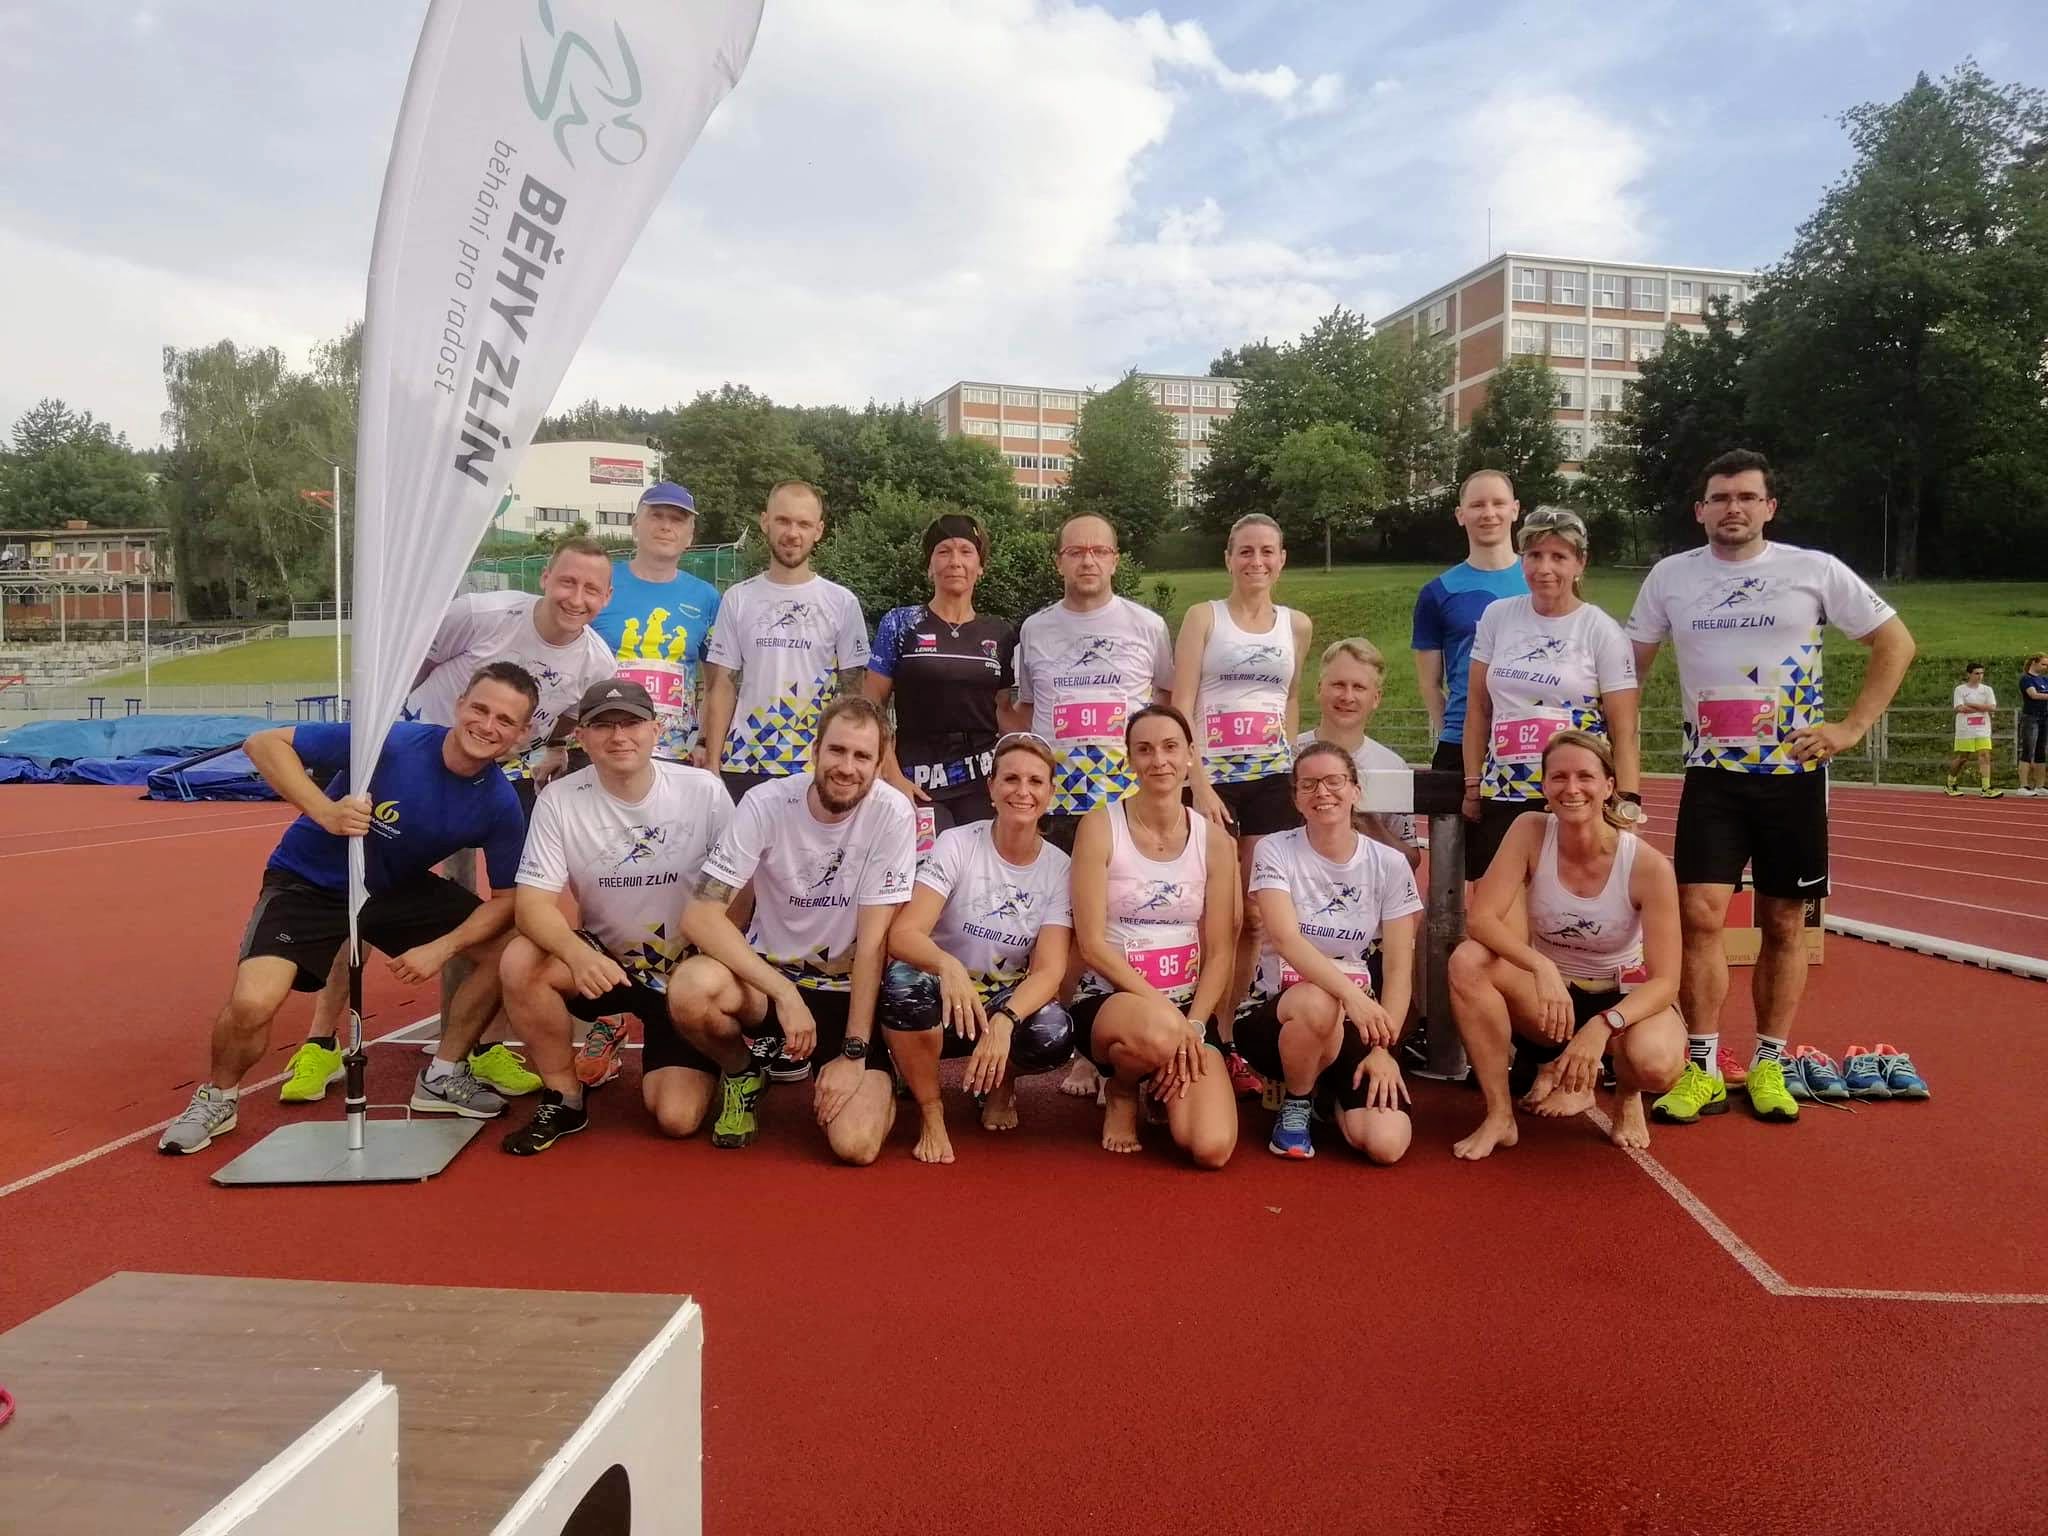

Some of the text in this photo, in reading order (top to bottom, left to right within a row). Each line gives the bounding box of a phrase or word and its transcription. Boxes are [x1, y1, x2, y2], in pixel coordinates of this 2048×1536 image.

[434, 139, 518, 394] běhání pro radost
[454, 173, 568, 487] BĚHY ZLÍN
[1692, 614, 1776, 630] FREERUN ZLÍN
[788, 638, 812, 650] ZLÍN
[645, 675, 660, 693] 51
[1053, 671, 1121, 688] FREERUN ZLÍN
[1493, 667, 1561, 687] FREERUN ZLÍN
[1080, 707, 1097, 727] 91
[1233, 717, 1254, 736] 97
[1519, 723, 1540, 743] 62
[598, 871, 679, 889] FREERUN ZLÍN
[963, 921, 1032, 947] FREERUN ZLÍN
[1336, 928, 1366, 942] ZLÍN
[1134, 954, 1145, 962] KM
[1159, 954, 1180, 977] 95
